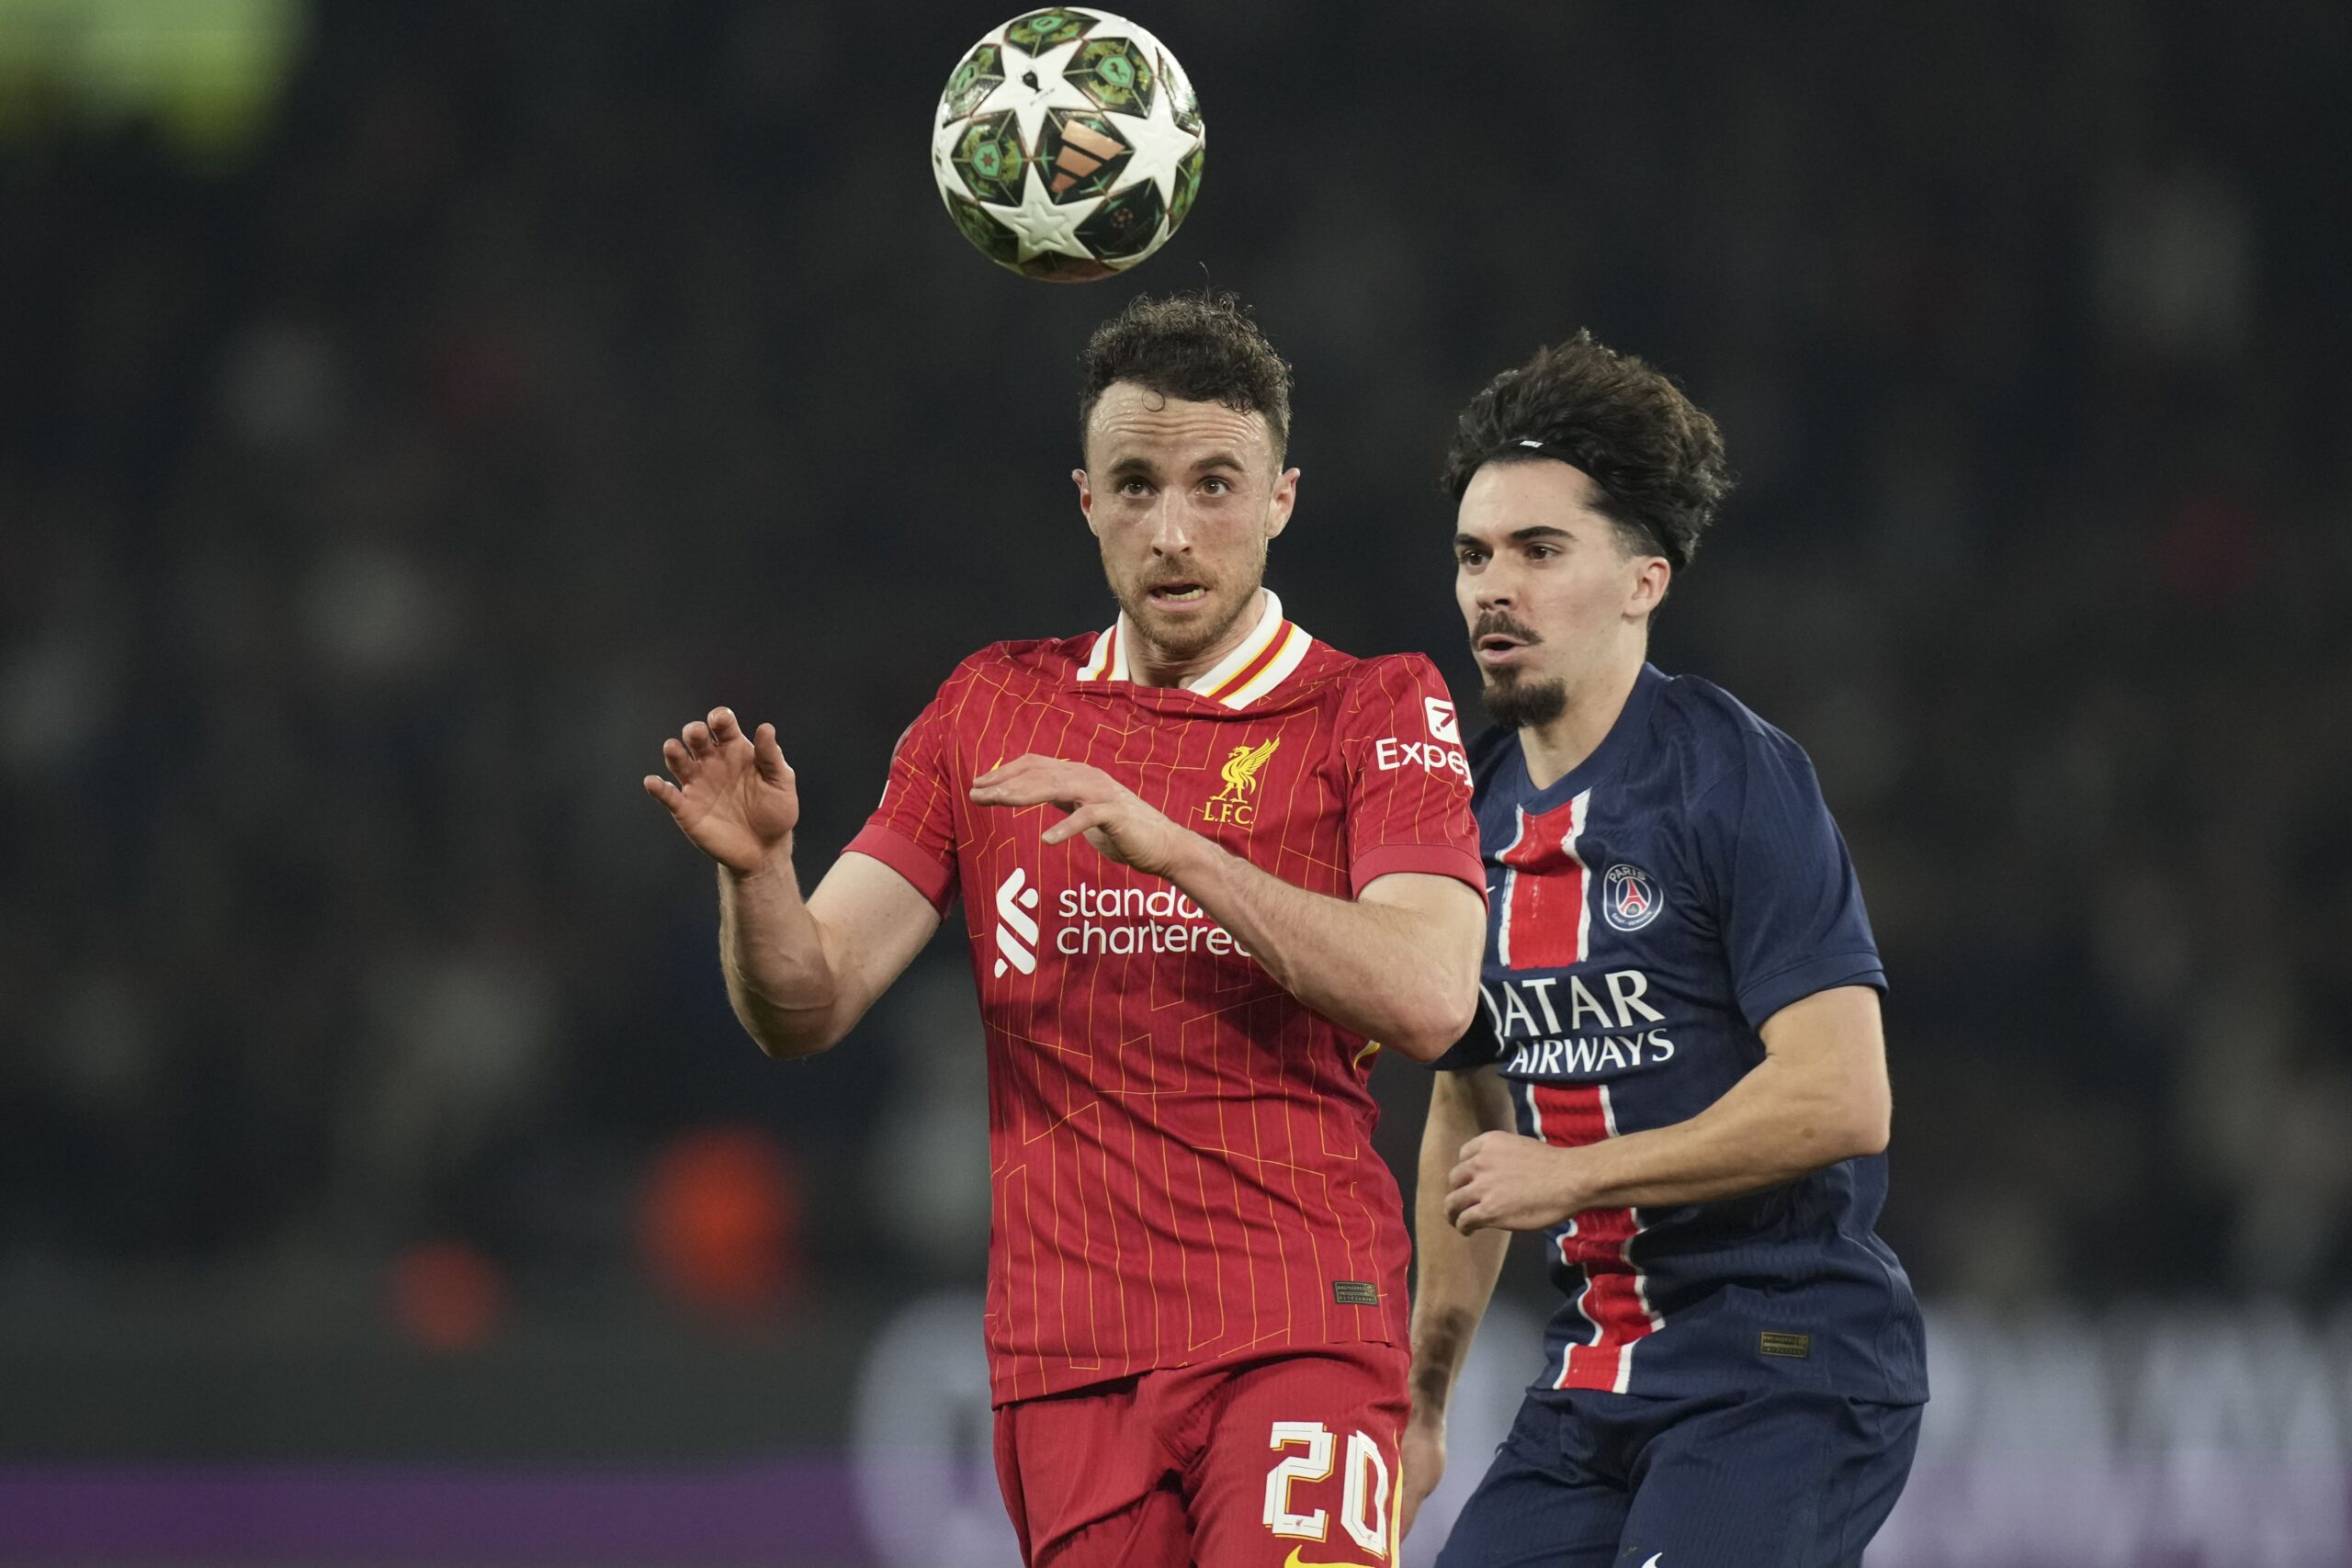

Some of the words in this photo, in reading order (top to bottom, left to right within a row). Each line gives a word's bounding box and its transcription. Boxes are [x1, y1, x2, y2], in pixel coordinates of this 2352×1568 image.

[1375, 738, 1474, 787] Expe
[1609, 866, 1645, 883] PARIS
[1058, 882, 1212, 919] standa
[1507, 1028, 1675, 1074] AIRWAYS
[1262, 1422, 1389, 1561] 20
